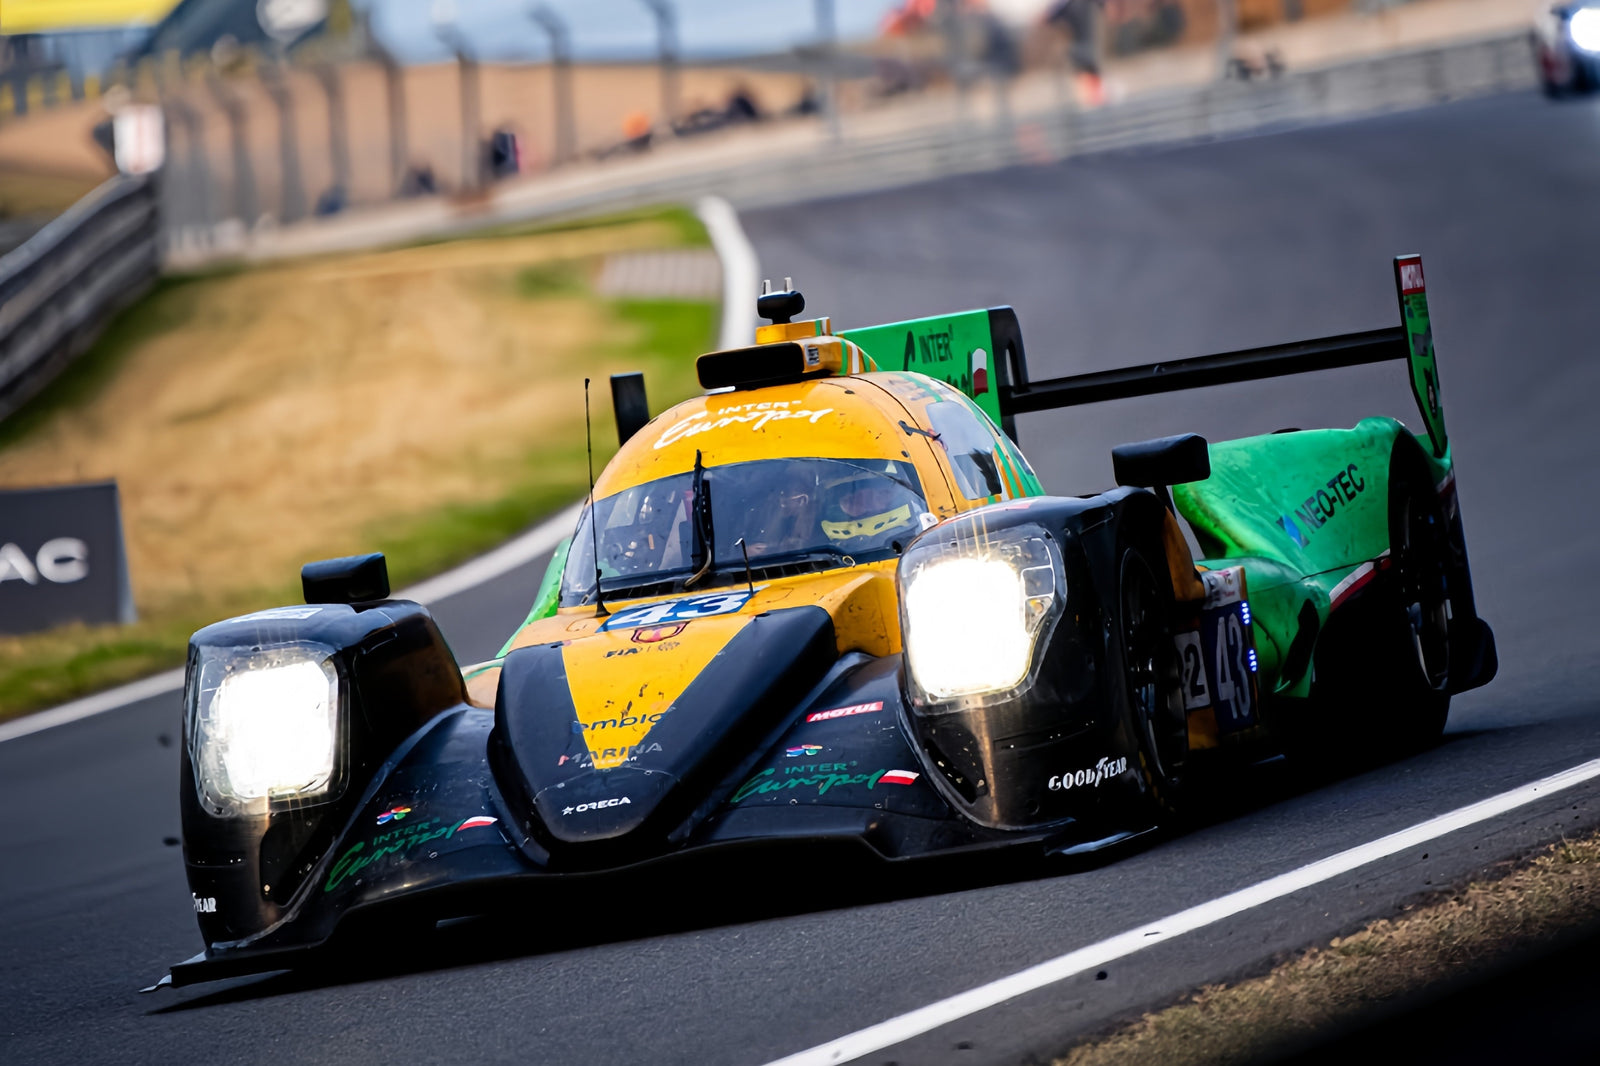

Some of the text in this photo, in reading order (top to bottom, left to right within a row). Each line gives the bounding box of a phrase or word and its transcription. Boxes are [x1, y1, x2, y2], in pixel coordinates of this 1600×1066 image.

[718, 401, 791, 415] INTER
[1294, 464, 1365, 534] NEO-TEC
[608, 593, 750, 625] 43
[1216, 612, 1251, 719] 43
[809, 703, 880, 722] MOTUL
[785, 763, 848, 774] INTER
[1048, 756, 1127, 791] GOODYEAR
[575, 796, 631, 812] ORECA
